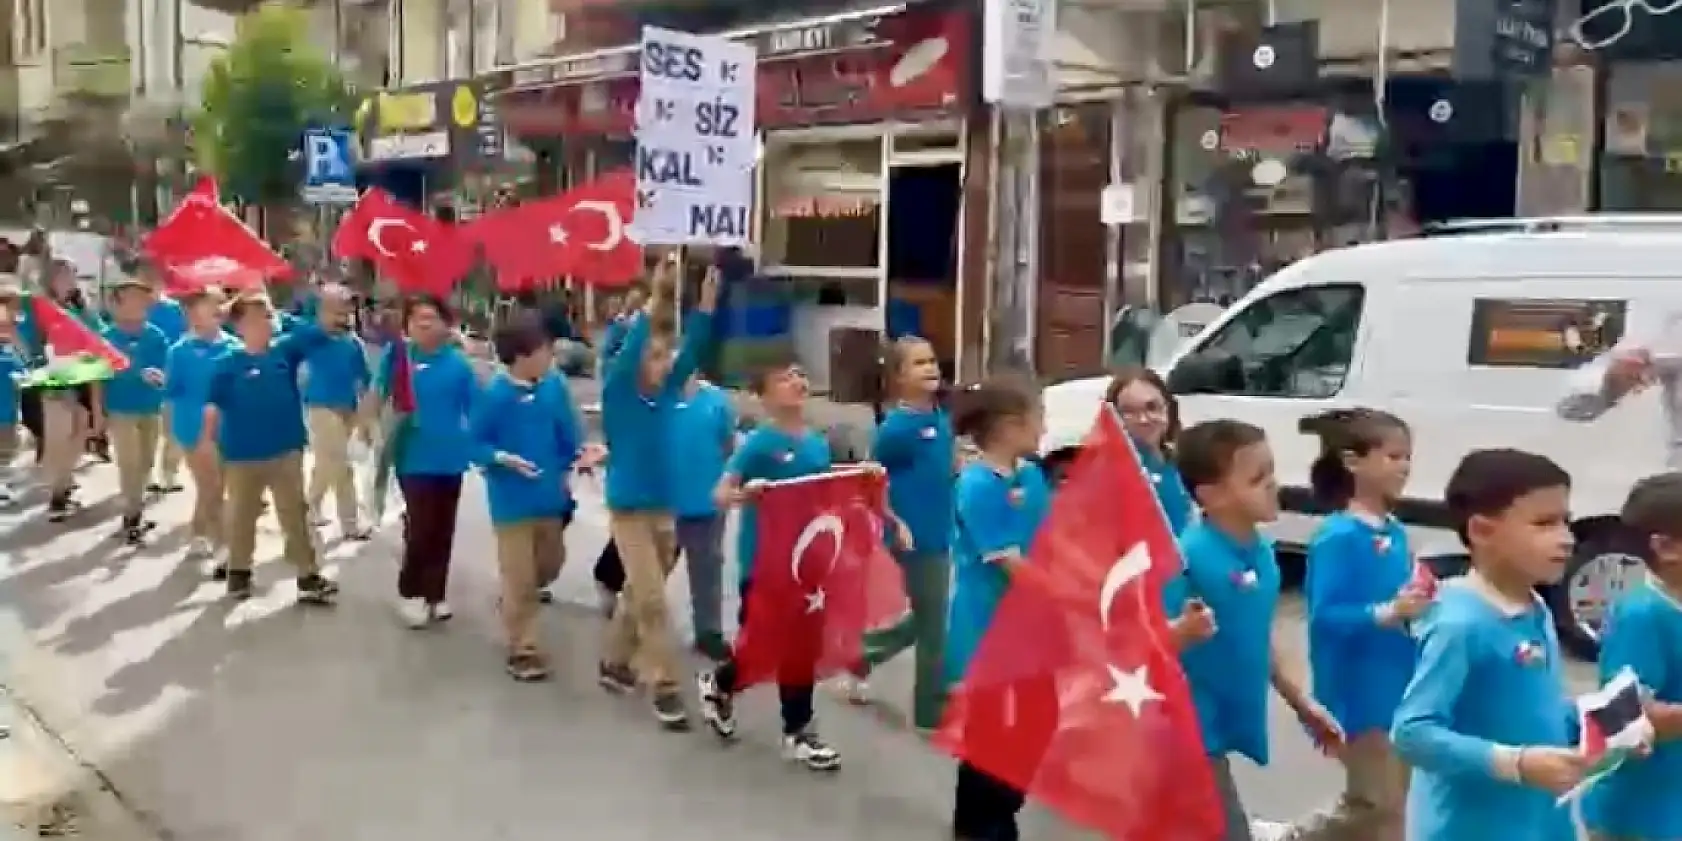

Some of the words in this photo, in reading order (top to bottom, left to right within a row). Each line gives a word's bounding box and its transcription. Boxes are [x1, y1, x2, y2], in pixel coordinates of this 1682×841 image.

[645, 41, 702, 81] SES
[695, 95, 739, 136] SİZ
[639, 146, 702, 185] KAL
